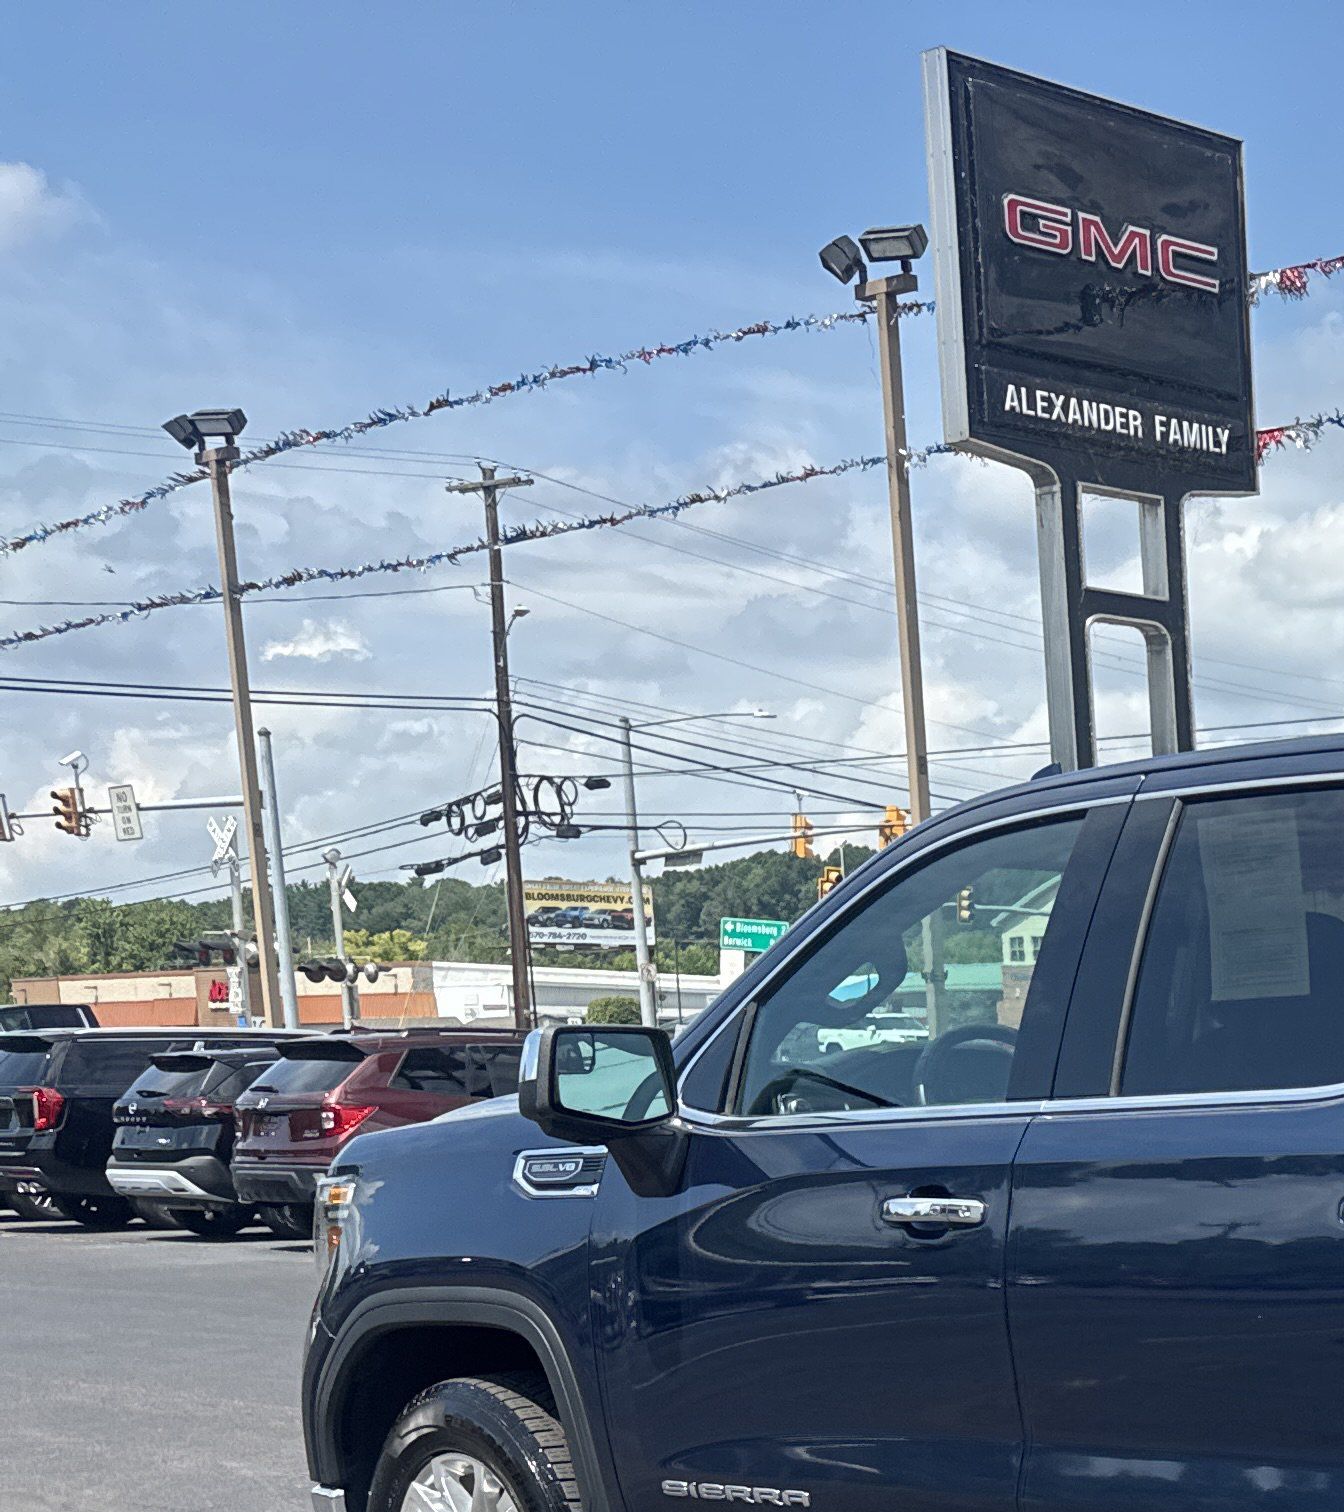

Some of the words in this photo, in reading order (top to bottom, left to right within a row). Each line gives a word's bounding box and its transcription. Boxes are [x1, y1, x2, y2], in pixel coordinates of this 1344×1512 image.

[1003, 193, 1219, 294] GMC
[1004, 384, 1144, 439] ALEXANDER
[1154, 414, 1230, 455] FAMILY
[115, 790, 128, 803] NO
[116, 804, 132, 814] TURN
[121, 815, 132, 825] ON
[122, 826, 135, 837] RED
[525, 892, 651, 906] BLOOMSBURGCHEVY.CM
[735, 923, 778, 937] Bloomsburg
[723, 936, 753, 948] Berwick
[661, 1479, 811, 1508] SIERRA
